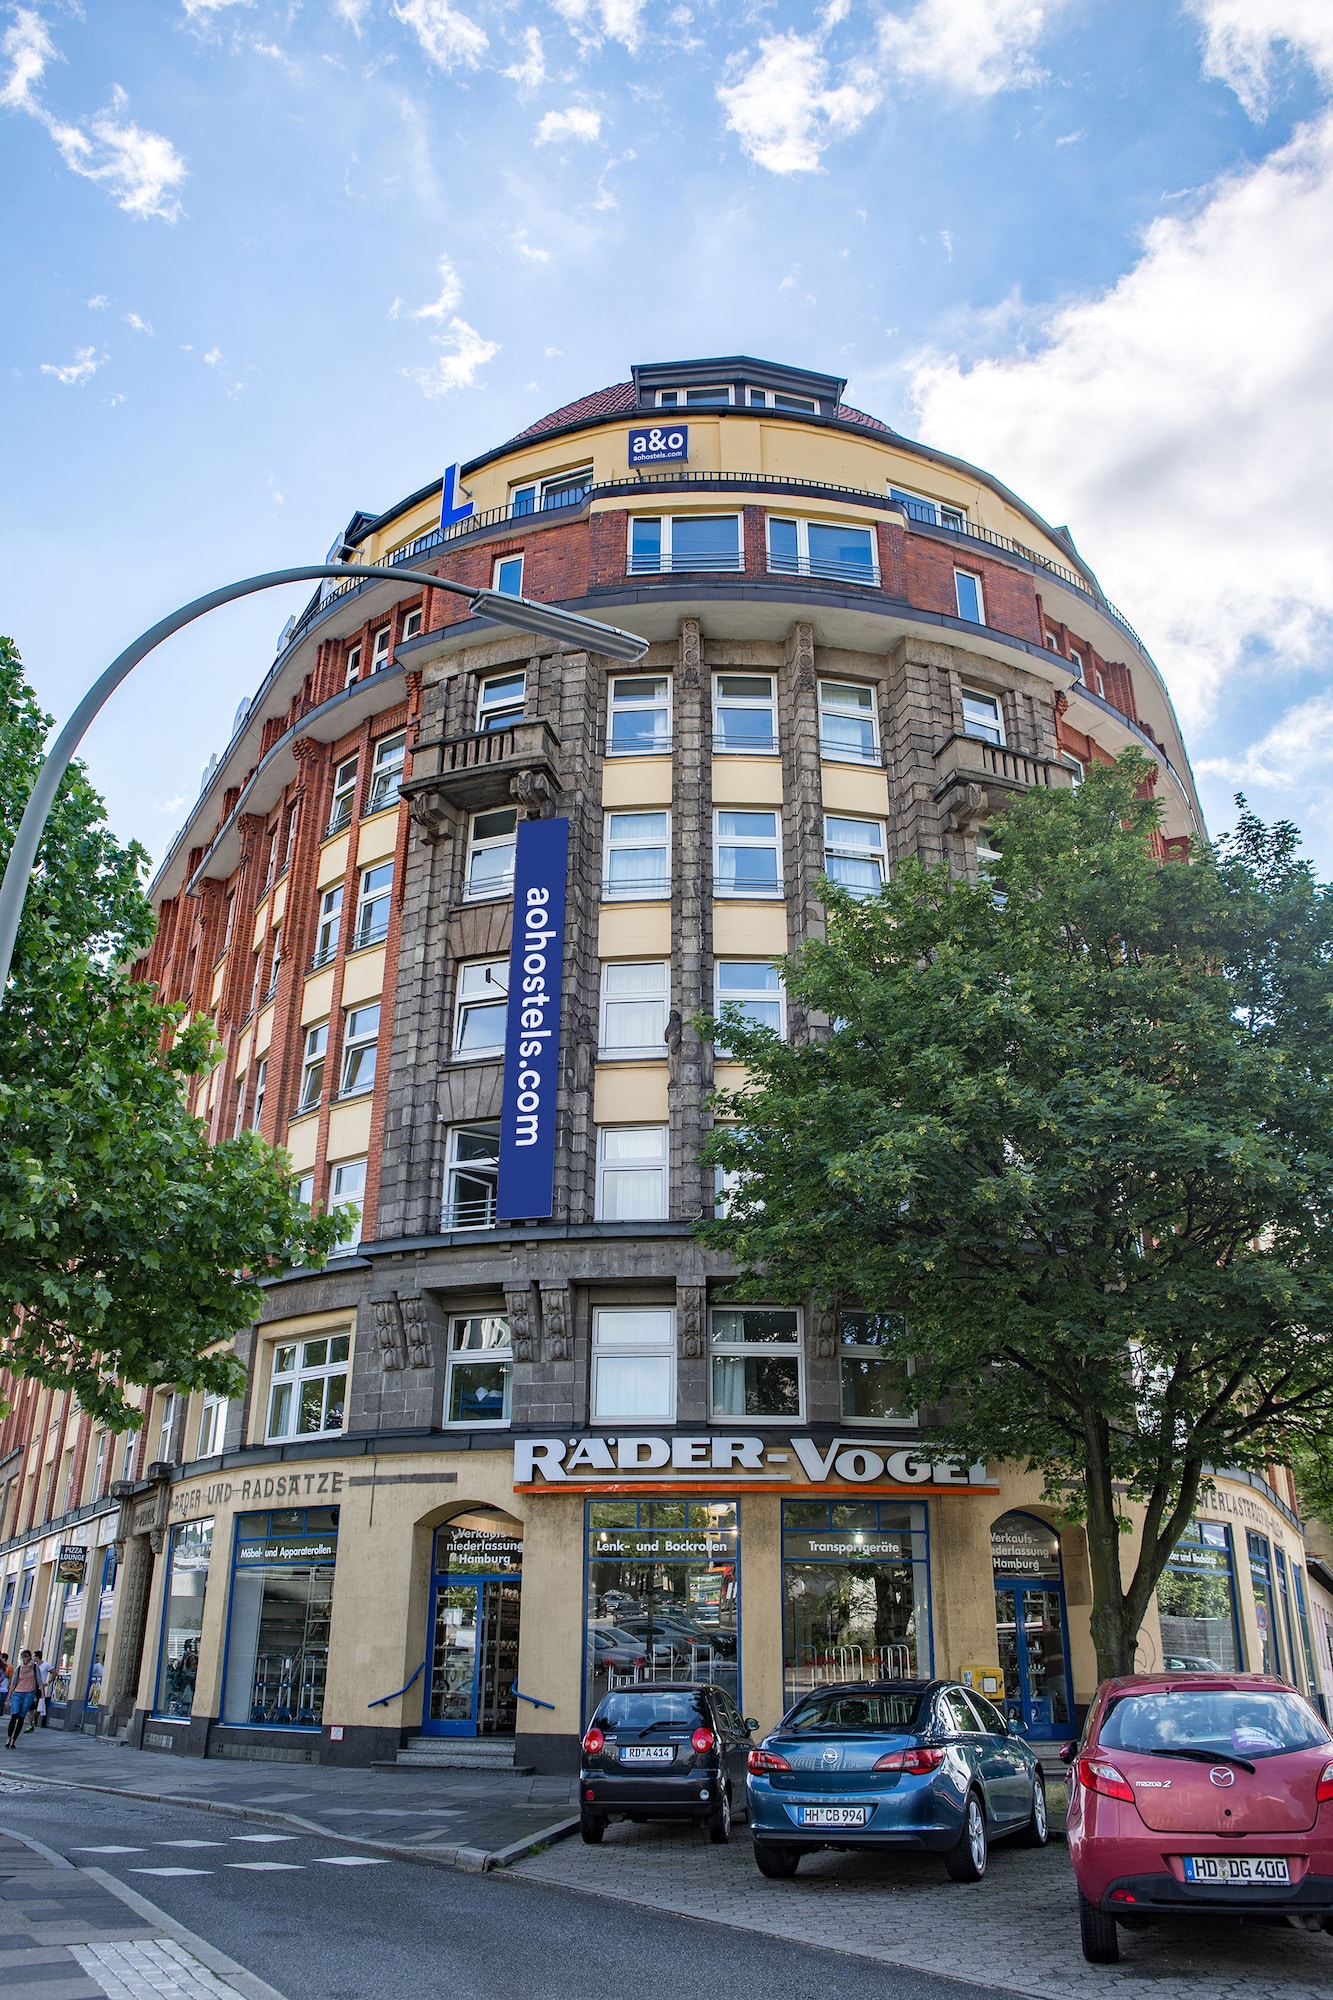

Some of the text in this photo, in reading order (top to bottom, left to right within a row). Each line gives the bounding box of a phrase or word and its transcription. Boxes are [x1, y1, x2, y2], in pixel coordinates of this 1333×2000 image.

[633, 429, 684, 453] a&o
[633, 451, 683, 461] aohostels.com
[515, 886, 557, 1147] aohostels.com
[208, 1483, 232, 1505] UND
[242, 1472, 343, 1500] RADSÄTZE
[64, 1546, 83, 1554] PIZZA
[240, 1544, 332, 1559] Möbel- und Apparaterollen
[446, 1540, 524, 1553] niederlassung
[596, 1540, 727, 1551] Lenk- und Bockrollen
[808, 1541, 900, 1556] Transportgeräte
[991, 1545, 1049, 1558] ederlassung
[60, 1553, 85, 1561] LOUNGE
[459, 1552, 511, 1566] Hamburg
[993, 1558, 1040, 1571] Hamburg
[629, 1748, 641, 1758] RD
[653, 1748, 670, 1758] 414
[1163, 1780, 1172, 1788] 2
[805, 1809, 863, 1822] HH CB 994
[1194, 1859, 1218, 1877] HD
[1228, 1860, 1251, 1878] DG
[1255, 1861, 1287, 1879] 400
